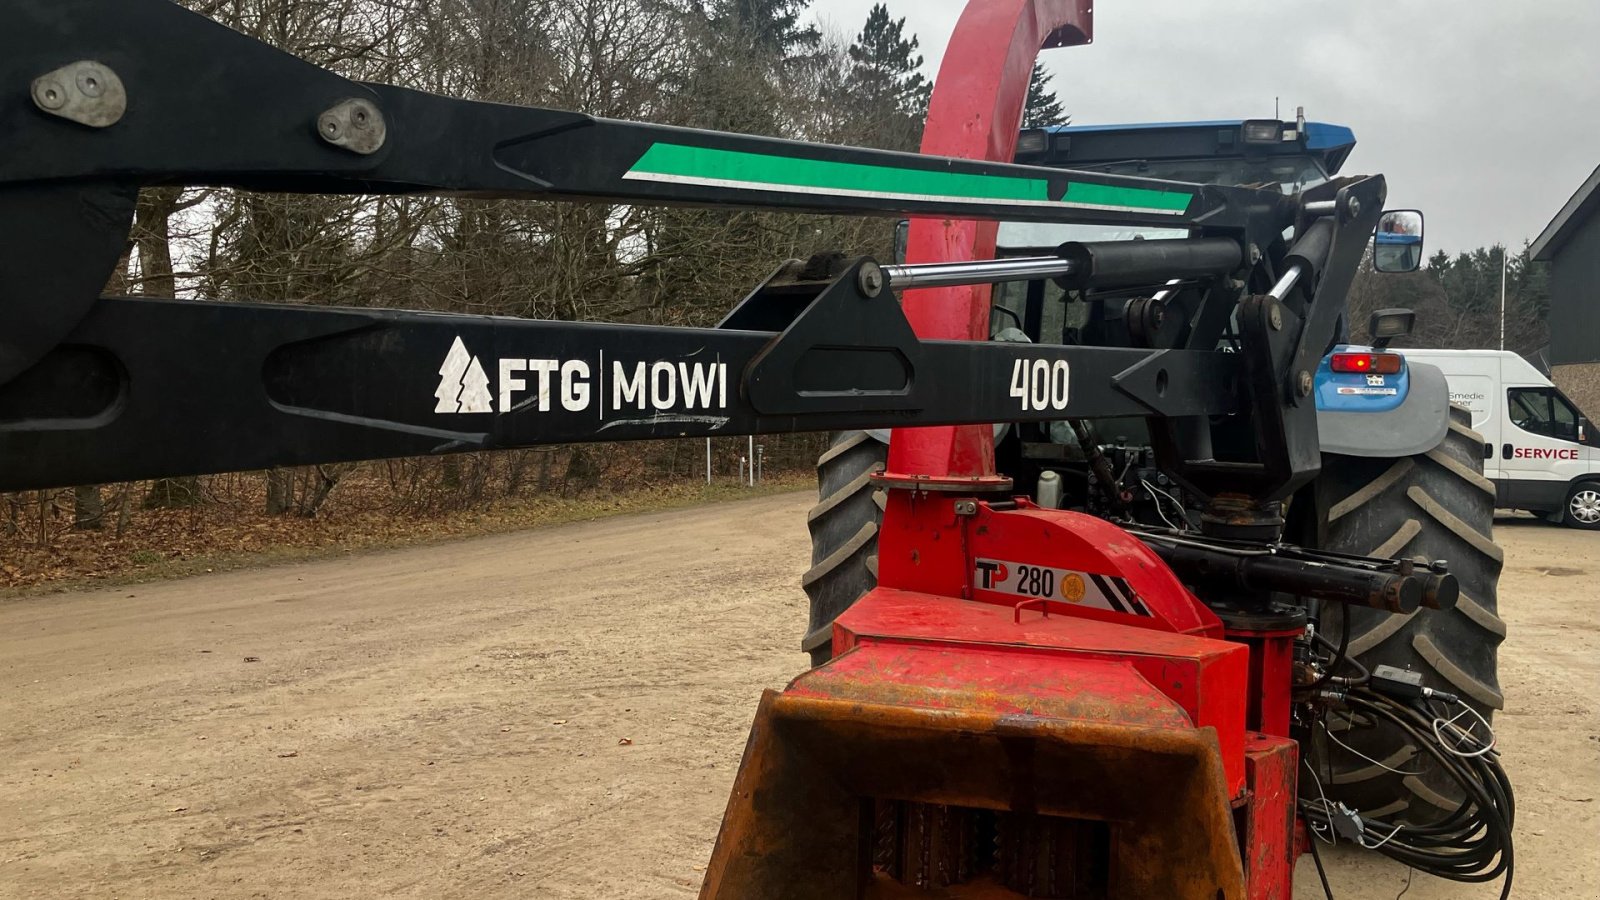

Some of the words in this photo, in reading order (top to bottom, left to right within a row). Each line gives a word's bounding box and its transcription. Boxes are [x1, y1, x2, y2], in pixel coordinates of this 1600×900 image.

[498, 358, 591, 412] FTG
[612, 360, 727, 410] MOWI
[1009, 358, 1070, 411] 400
[1514, 448, 1579, 460] SERVICE
[1016, 565, 1054, 598] 280
